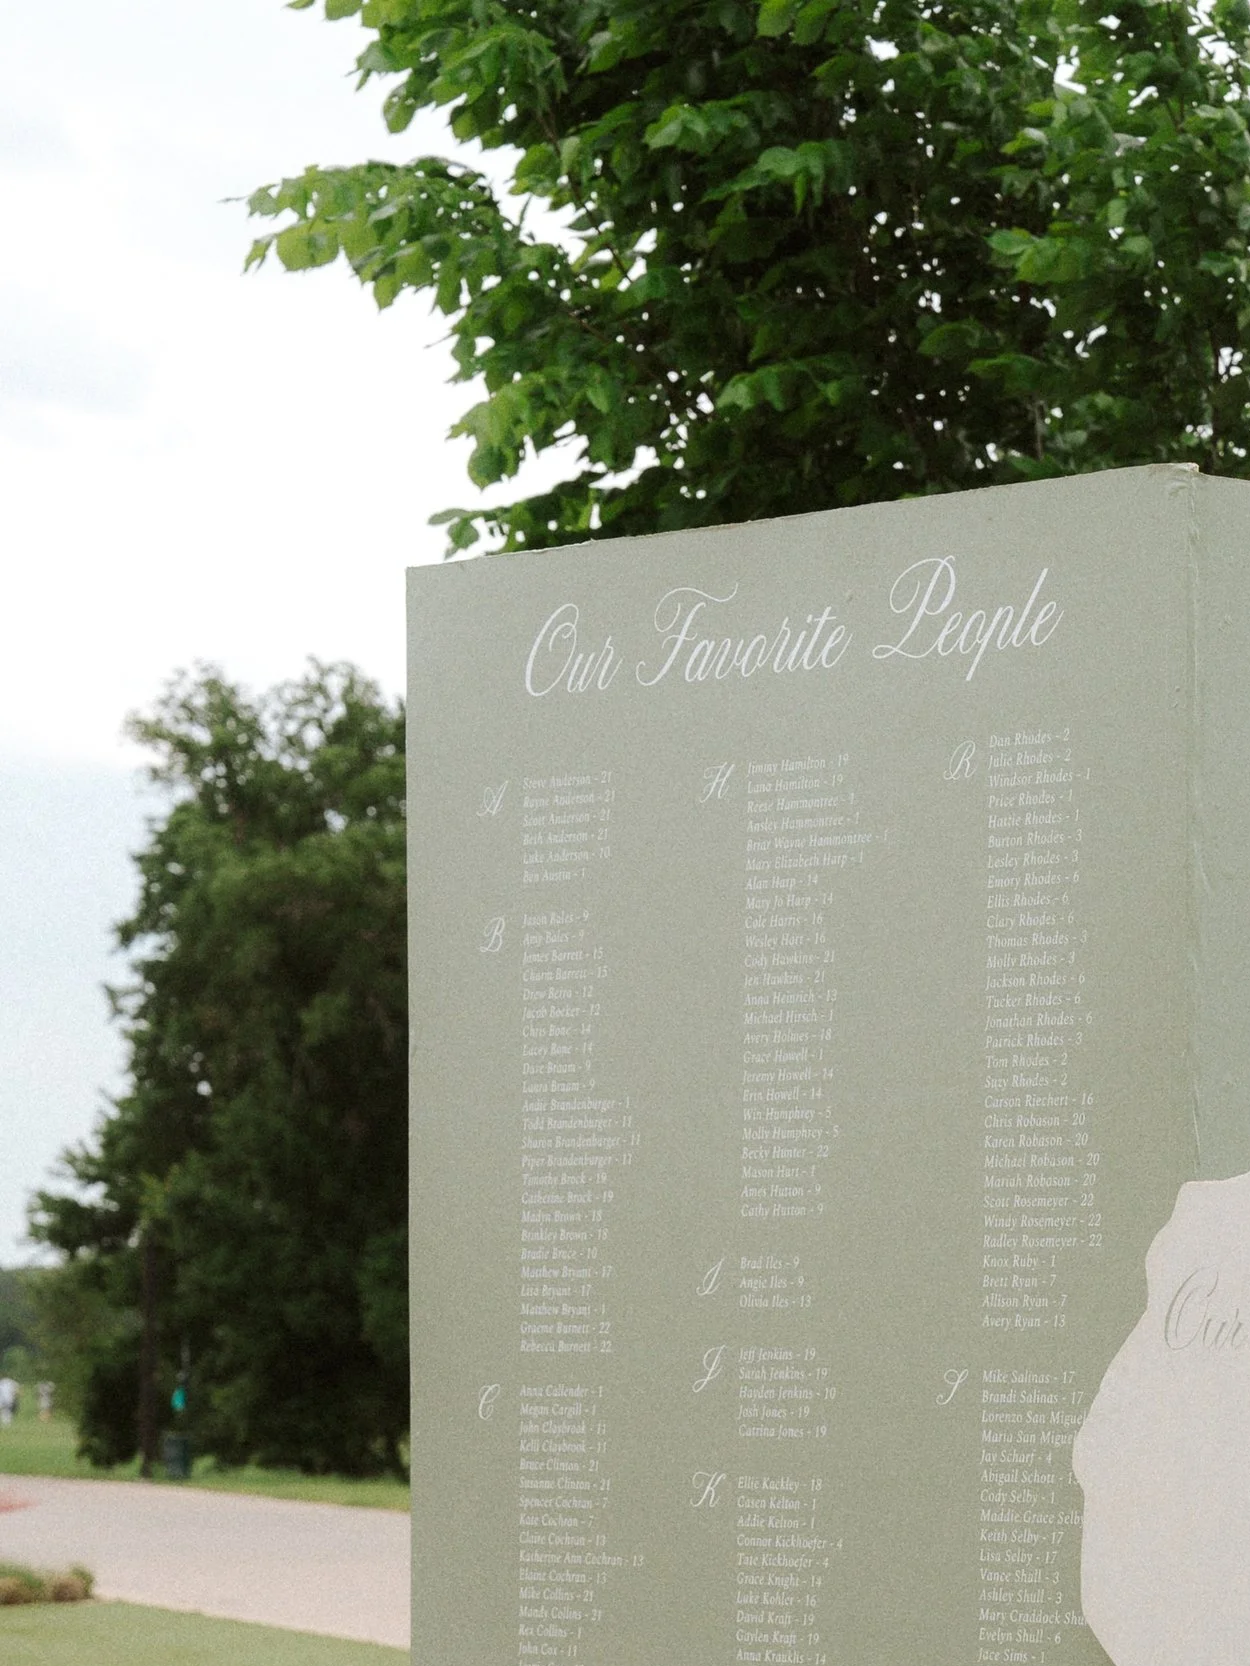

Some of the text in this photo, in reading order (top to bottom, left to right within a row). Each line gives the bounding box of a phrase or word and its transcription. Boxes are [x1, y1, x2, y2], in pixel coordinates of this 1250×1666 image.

[524, 555, 1064, 696] Our Favorite People
[989, 728, 1070, 748] Dan Rhodes 2
[943, 740, 978, 780] R
[988, 749, 1071, 770] Julie Rhodes 2
[550, 773, 591, 788] Anderson
[601, 771, 612, 783] 21
[699, 762, 735, 803] H
[748, 775, 843, 794] Lana Hamilton 19
[989, 768, 1090, 788] Windsor Rhodes 1
[477, 780, 509, 817] A
[988, 809, 1079, 828] Hattie Rhodes 1
[745, 875, 818, 891] Alan Harp 14
[988, 871, 1079, 890] Emory Rhodes 6
[480, 915, 505, 953] B
[987, 930, 1088, 948] Thomas Rhodes 3
[593, 947, 603, 959] 15
[985, 972, 1085, 991] Jackson Rhodes 6
[745, 990, 837, 1005] Anna Heinrich 13
[985, 1012, 1092, 1031] Jonathan Rhodes 6
[985, 1092, 1093, 1108] Carson Riechert 16
[984, 1113, 1085, 1128] Chris Robason 20
[742, 1146, 829, 1160] Becky Hunter 22
[983, 1234, 1102, 1251] Radley Rosemeyer 22
[740, 1256, 800, 1269] Brad Iles 9
[740, 1294, 811, 1308] Olivia Iles 13
[982, 1295, 1067, 1311] Allison Ryan 7
[1164, 1265, 1248, 1351] Our
[982, 1314, 1066, 1330] Avery Ryan 13
[936, 1369, 969, 1405] S
[478, 1384, 500, 1420] C
[982, 1390, 1083, 1404] Brandi Salinas 17
[737, 1405, 809, 1420] Josh Jones 19
[690, 1471, 727, 1508] K
[738, 1476, 822, 1493] Ellie Kackley 18
[980, 1529, 1064, 1545] Keith Selby 17
[519, 1588, 593, 1602] Mike Collins 21
[518, 1643, 578, 1657] John Cox 11
